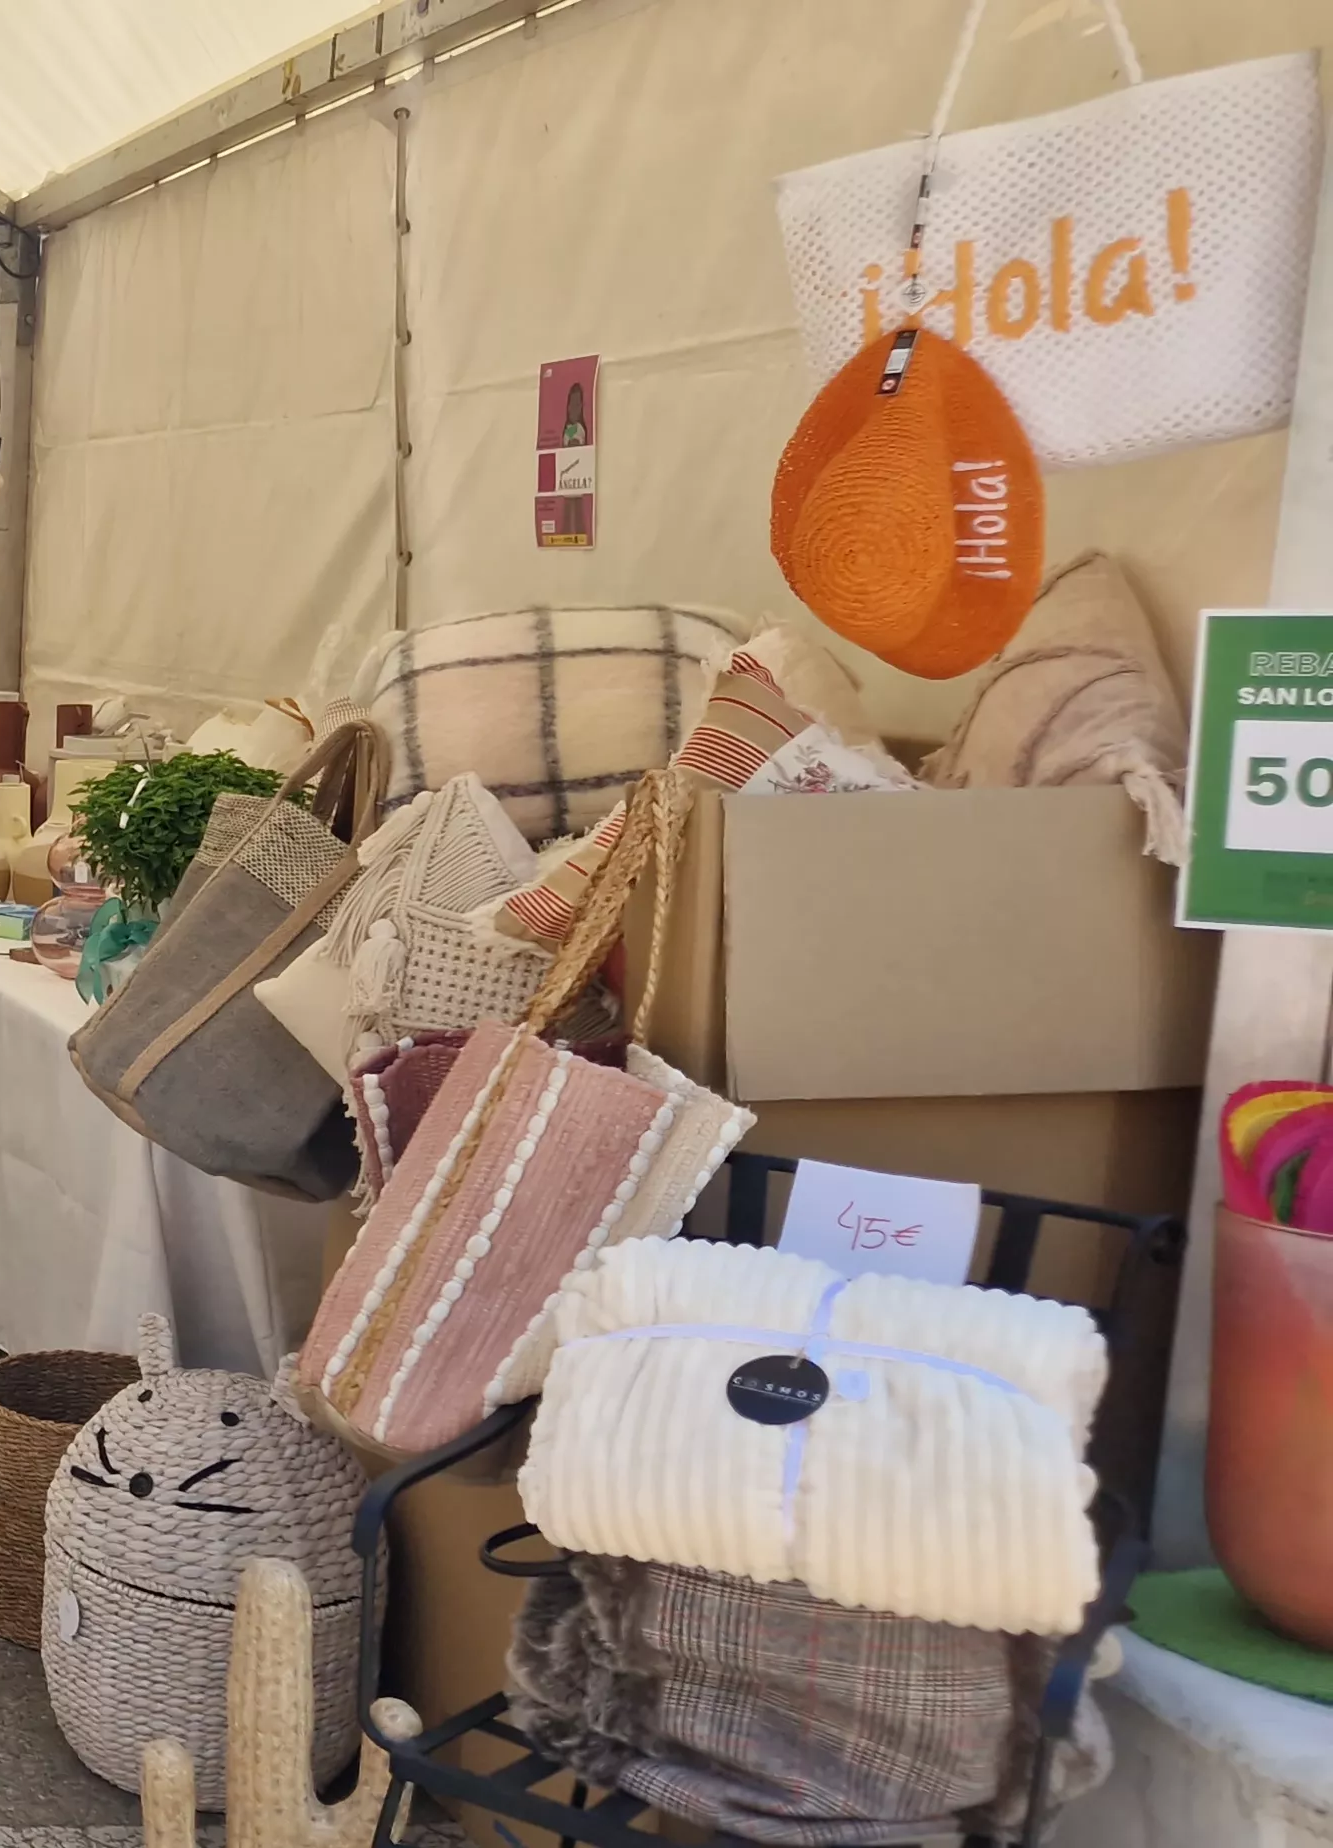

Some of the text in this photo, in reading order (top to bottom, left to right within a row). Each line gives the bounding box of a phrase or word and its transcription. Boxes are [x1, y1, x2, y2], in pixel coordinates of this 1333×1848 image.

[953, 460, 1011, 579] ¡Hola!
[1237, 686, 1297, 706] SAN
[1245, 756, 1333, 808] 50
[837, 1201, 924, 1250] 45€
[733, 1376, 822, 1403] COSMOS
